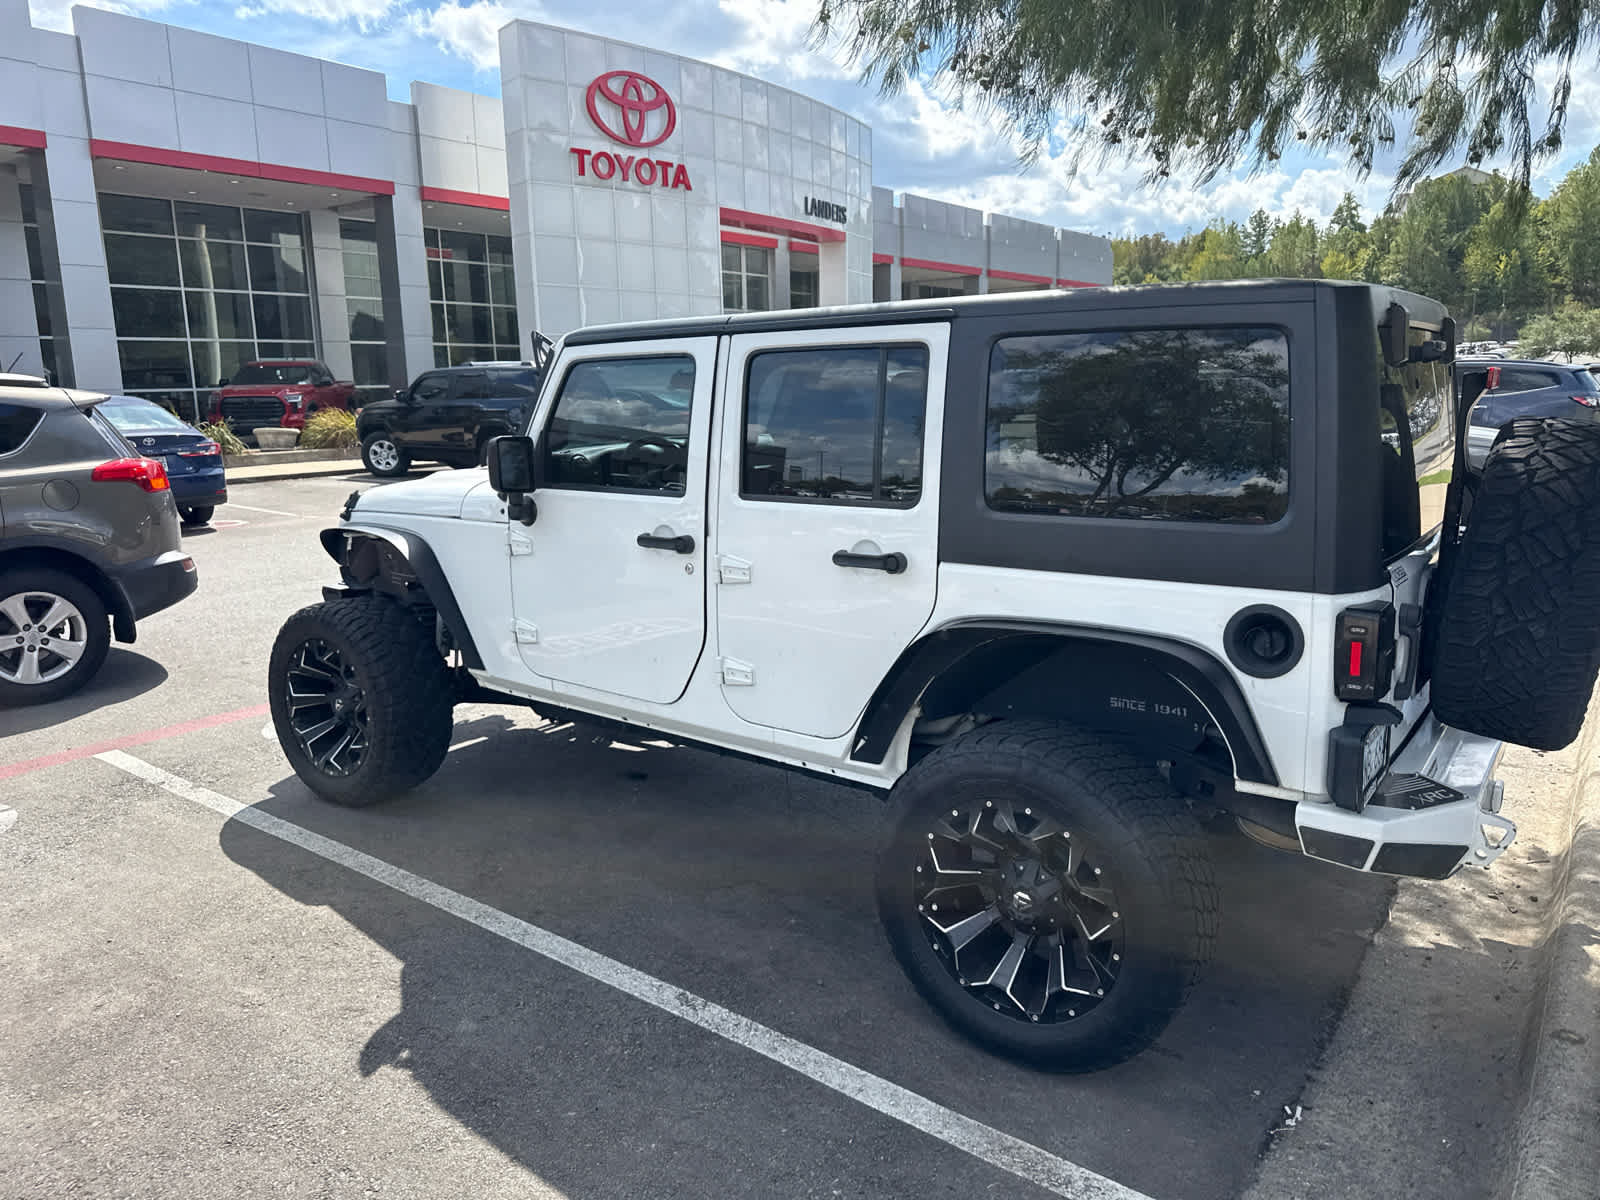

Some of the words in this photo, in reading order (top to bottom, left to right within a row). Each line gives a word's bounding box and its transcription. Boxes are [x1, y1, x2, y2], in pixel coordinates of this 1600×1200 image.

[569, 147, 693, 191] TOYOTA
[804, 196, 847, 224] LANDERS
[1154, 703, 1187, 717] 1941
